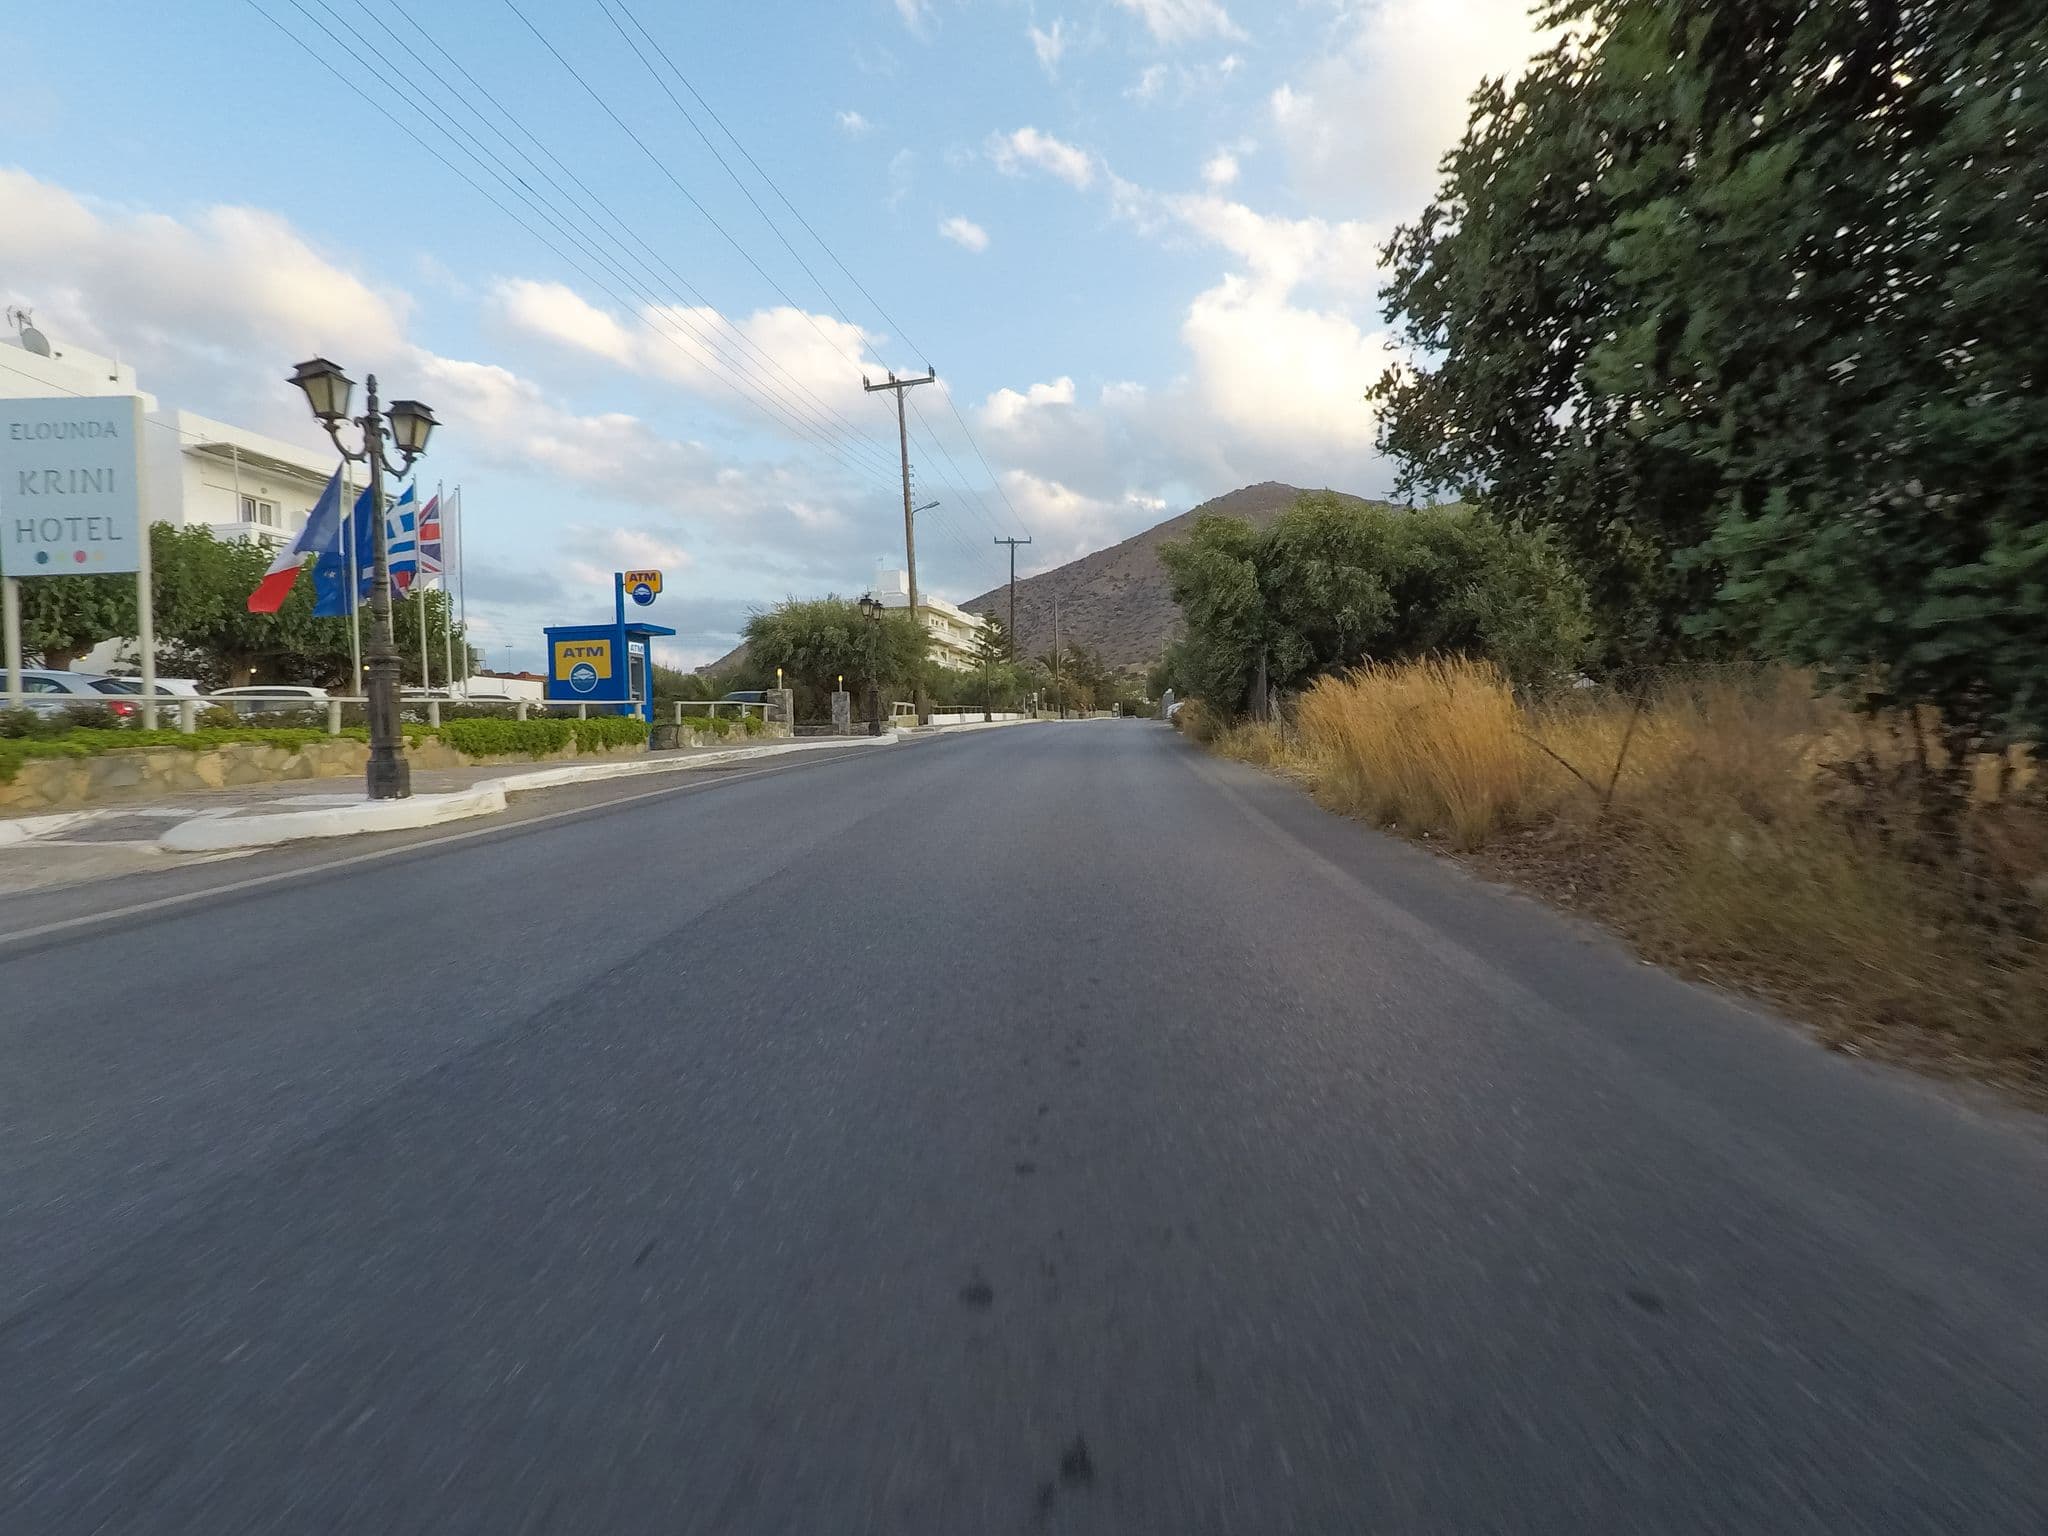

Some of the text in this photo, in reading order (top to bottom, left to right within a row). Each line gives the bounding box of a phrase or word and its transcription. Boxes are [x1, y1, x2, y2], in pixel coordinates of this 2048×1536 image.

[9, 421, 119, 440] ELOUNDA
[18, 468, 115, 495] KRINI
[15, 516, 123, 543] HOTEL
[629, 573, 657, 582] ATM
[563, 647, 604, 658] ATM
